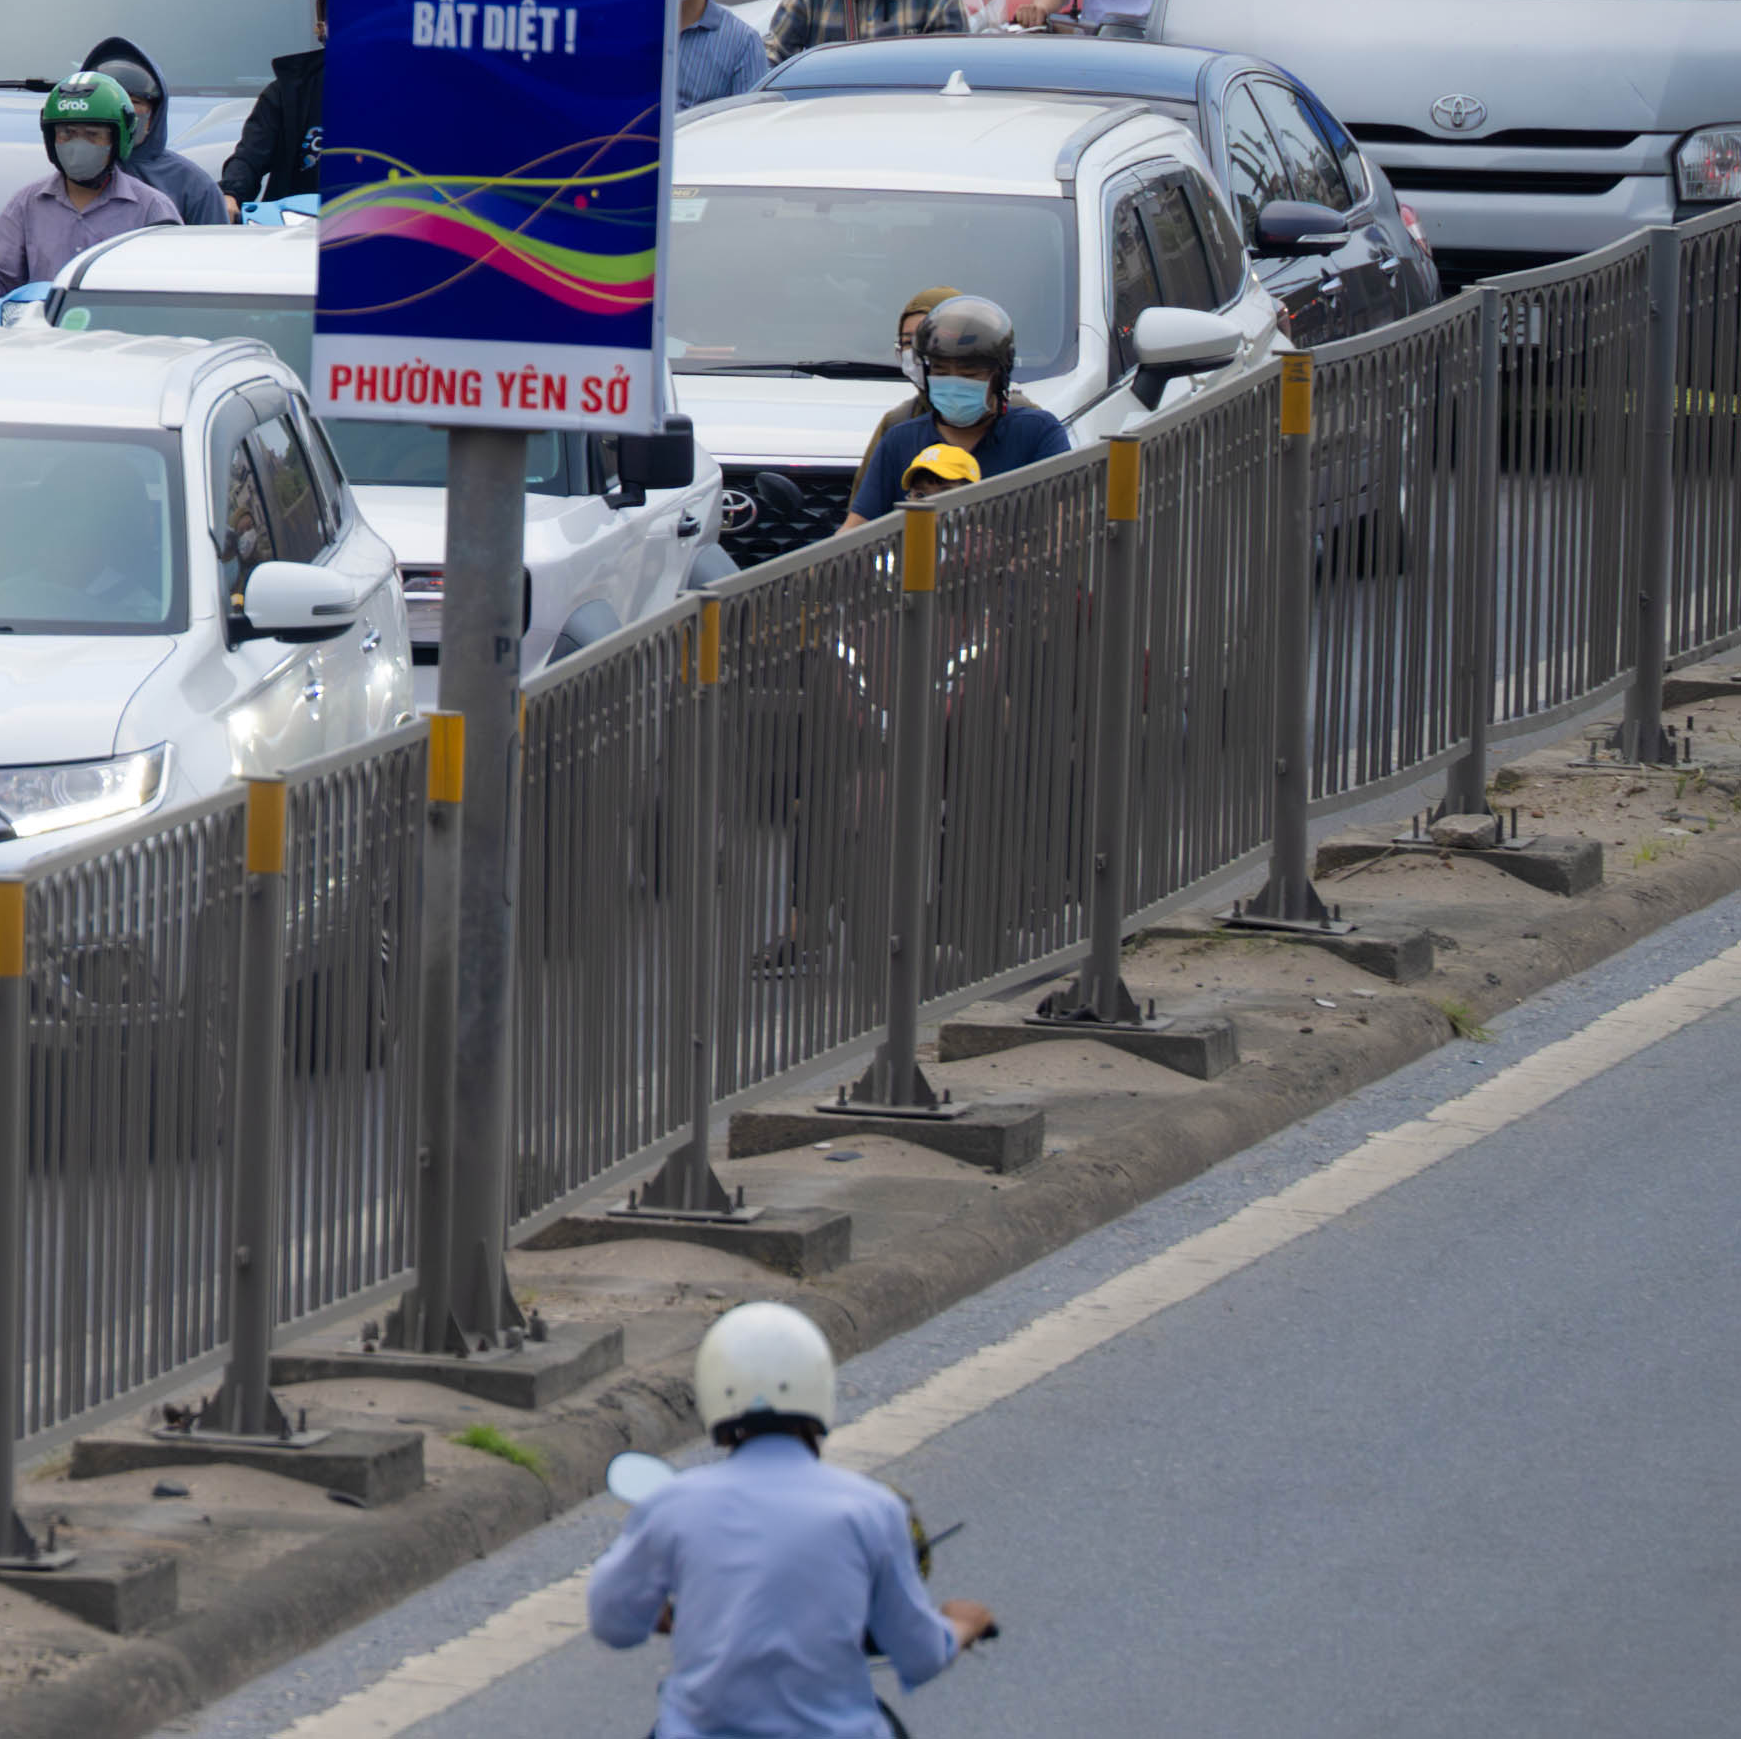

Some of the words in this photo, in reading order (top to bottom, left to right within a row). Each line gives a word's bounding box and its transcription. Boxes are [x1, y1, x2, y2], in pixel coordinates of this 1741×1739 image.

[481, 0, 559, 62] DIỆT
[564, 7, 578, 55] !
[57, 98, 89, 112] Grab
[328, 359, 482, 409] PHƯỜNG
[495, 364, 569, 411] YÊN
[581, 364, 632, 416] SỞ
